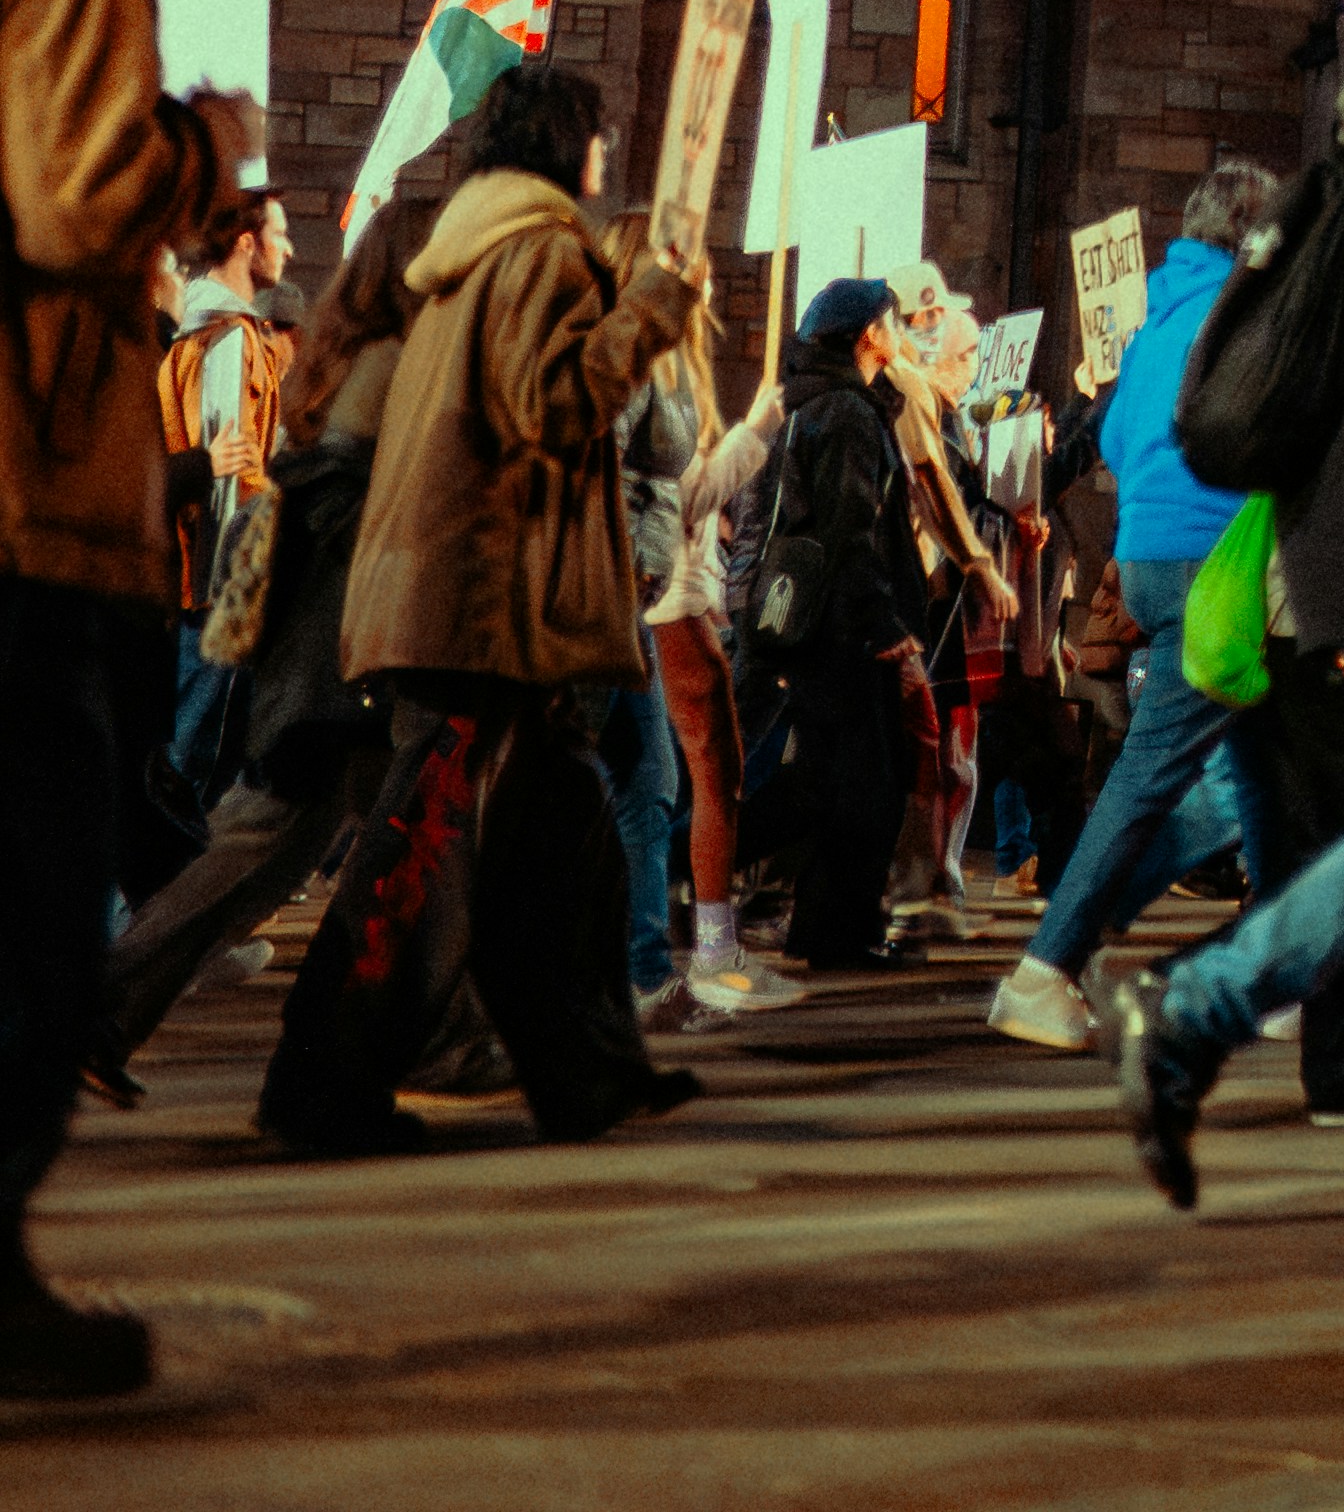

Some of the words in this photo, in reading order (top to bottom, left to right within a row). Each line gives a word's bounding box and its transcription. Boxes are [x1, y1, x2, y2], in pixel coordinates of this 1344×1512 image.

[1080, 244, 1103, 293] EAT
[1105, 234, 1141, 287] SHIT
[992, 324, 1029, 383] LOVE
